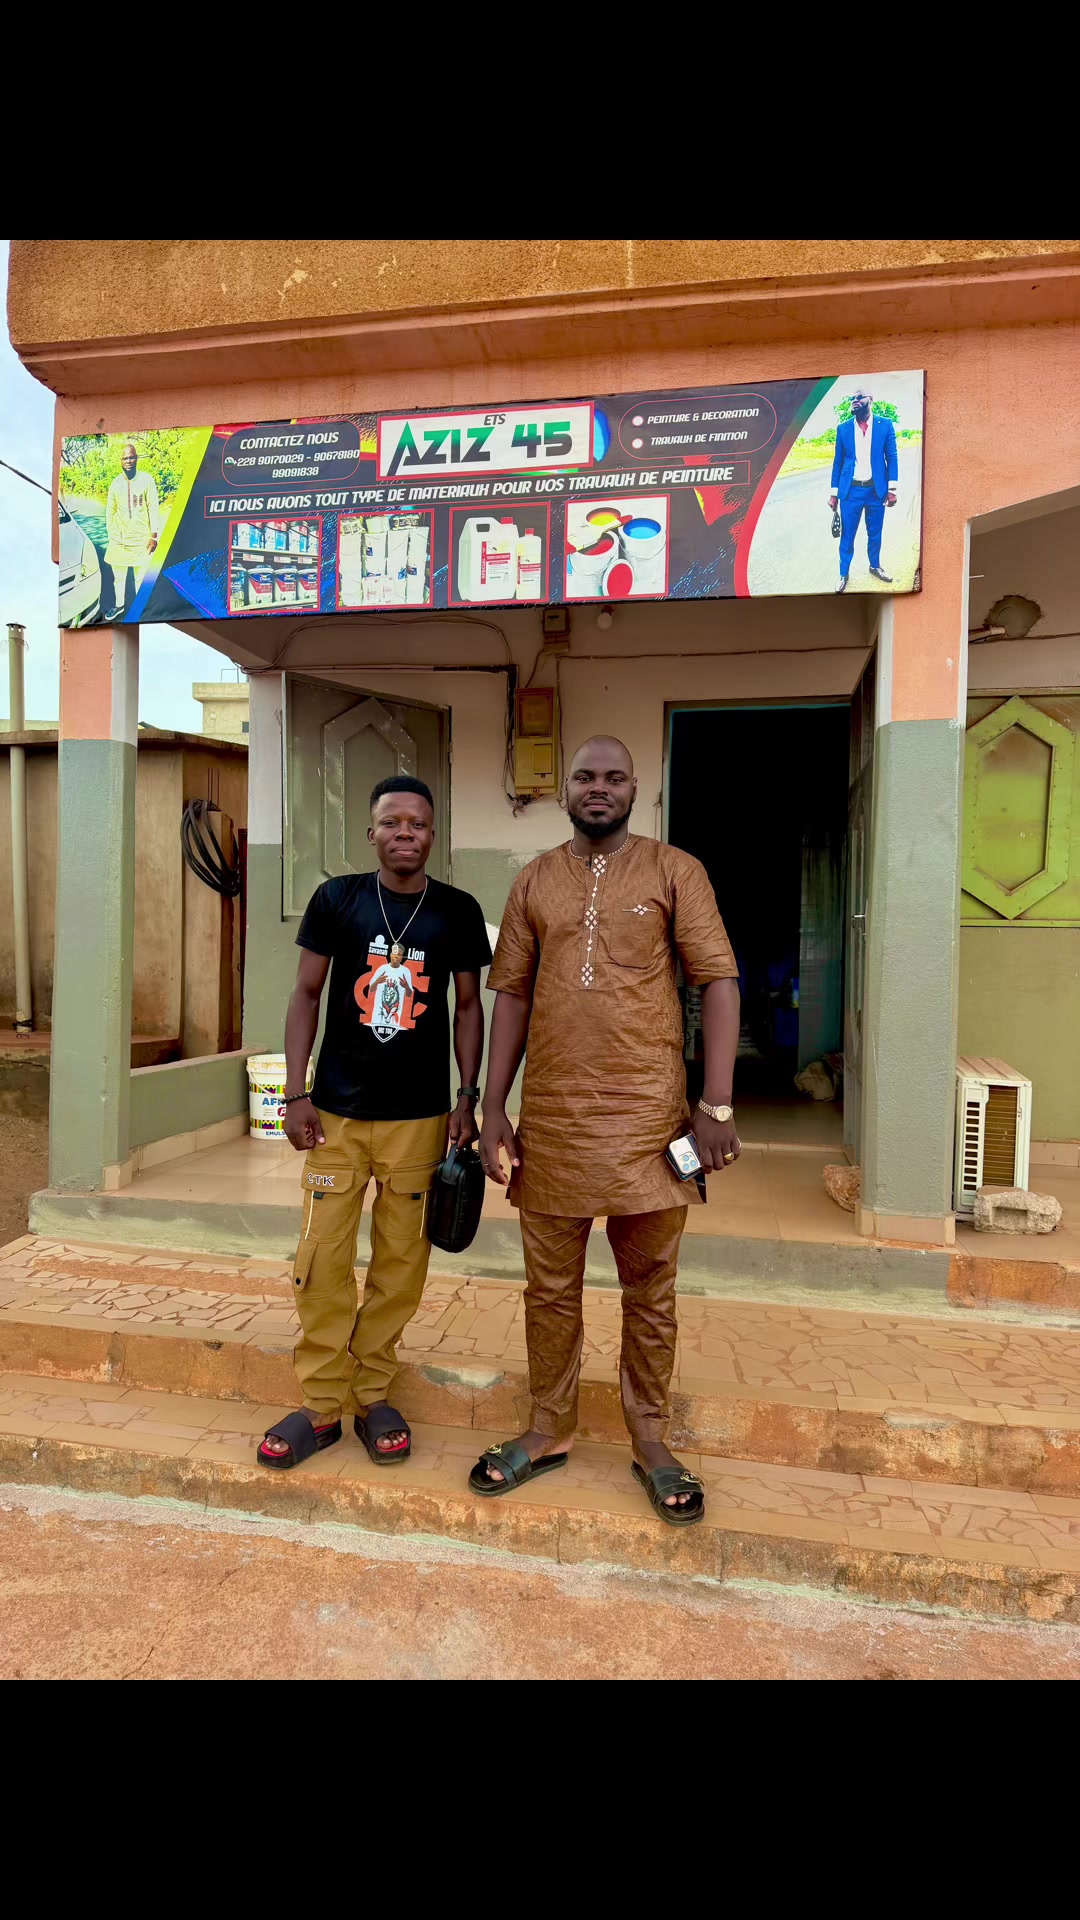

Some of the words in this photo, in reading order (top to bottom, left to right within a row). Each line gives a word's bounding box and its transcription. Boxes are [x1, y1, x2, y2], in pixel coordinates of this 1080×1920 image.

[483, 413, 506, 426] ETS
[647, 413, 690, 425] PEINTURE
[692, 412, 699, 422] &
[701, 408, 759, 421] DECORATION
[240, 434, 305, 450] CONTACTEZ
[306, 431, 339, 445] NOUS
[694, 433, 706, 443] DE
[708, 431, 748, 442] FINITION
[386, 421, 495, 477] AZIZ
[511, 420, 573, 459] 45
[257, 454, 304, 466] 90170029
[313, 449, 360, 462] 90678180
[271, 466, 319, 478] 99091838
[209, 500, 226, 513] ICI
[228, 498, 264, 512] NOUS
[315, 492, 349, 507] TOUT
[352, 489, 384, 505] TYPE
[388, 487, 405, 501] DE
[492, 481, 531, 496] POUR
[639, 469, 660, 485] DE
[662, 466, 735, 484] PEINTURE
[407, 948, 425, 961] Lion
[307, 1172, 336, 1187] CTK
